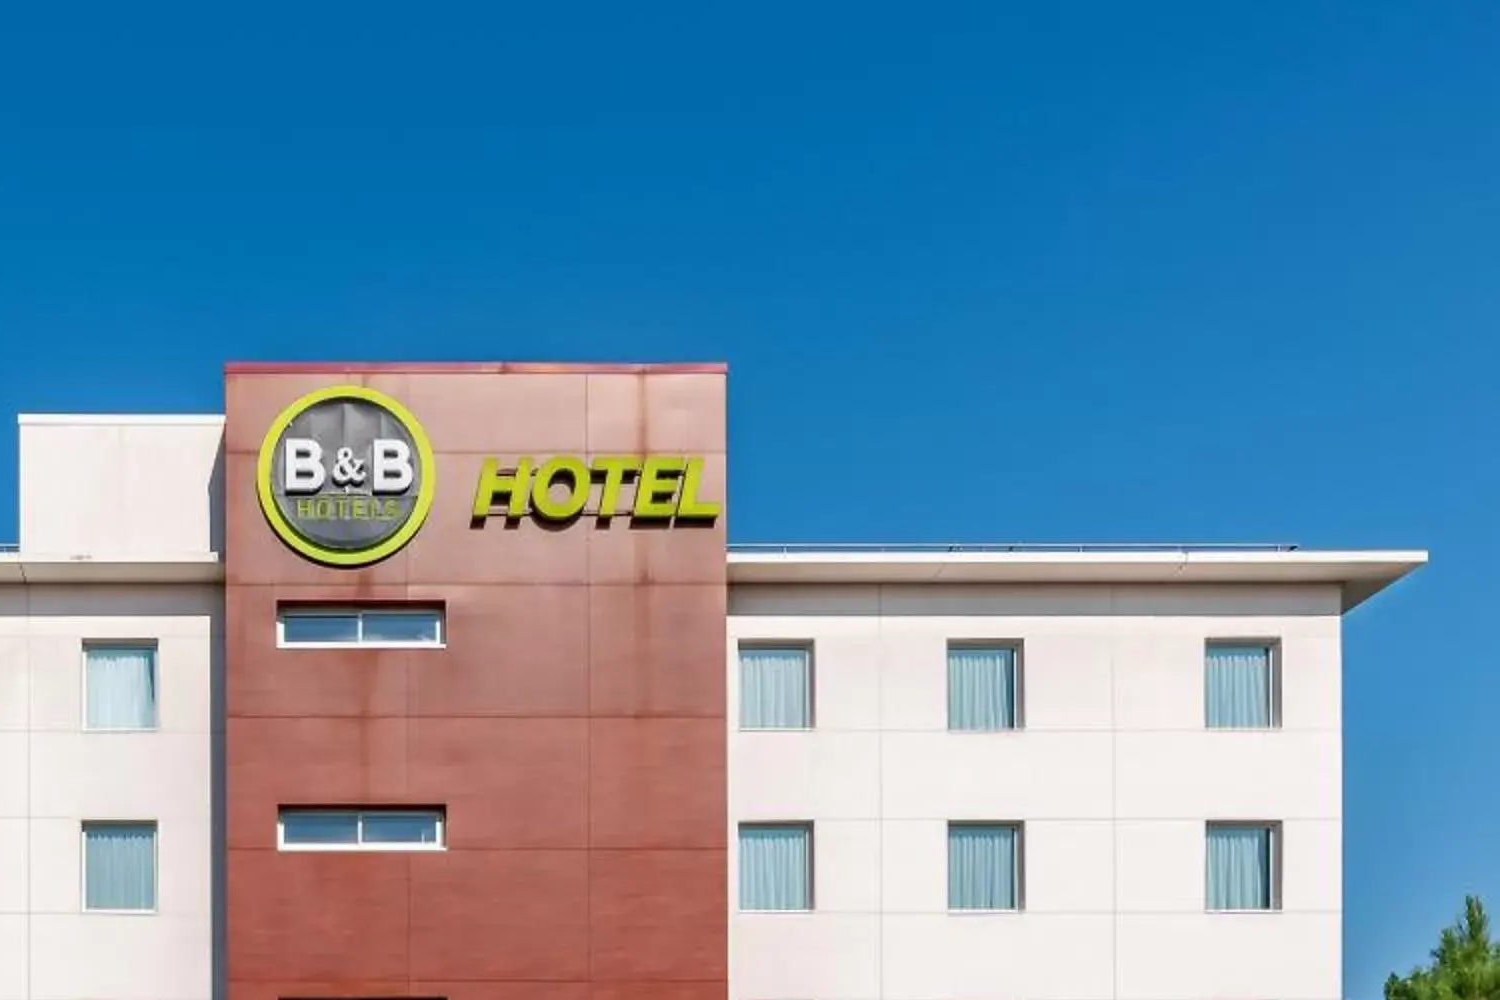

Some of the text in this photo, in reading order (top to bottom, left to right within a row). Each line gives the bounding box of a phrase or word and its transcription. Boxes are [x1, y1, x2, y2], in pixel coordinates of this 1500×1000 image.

[285, 438, 414, 492] B&B
[473, 456, 722, 520] HOTEL
[296, 499, 400, 520] HOTELS
